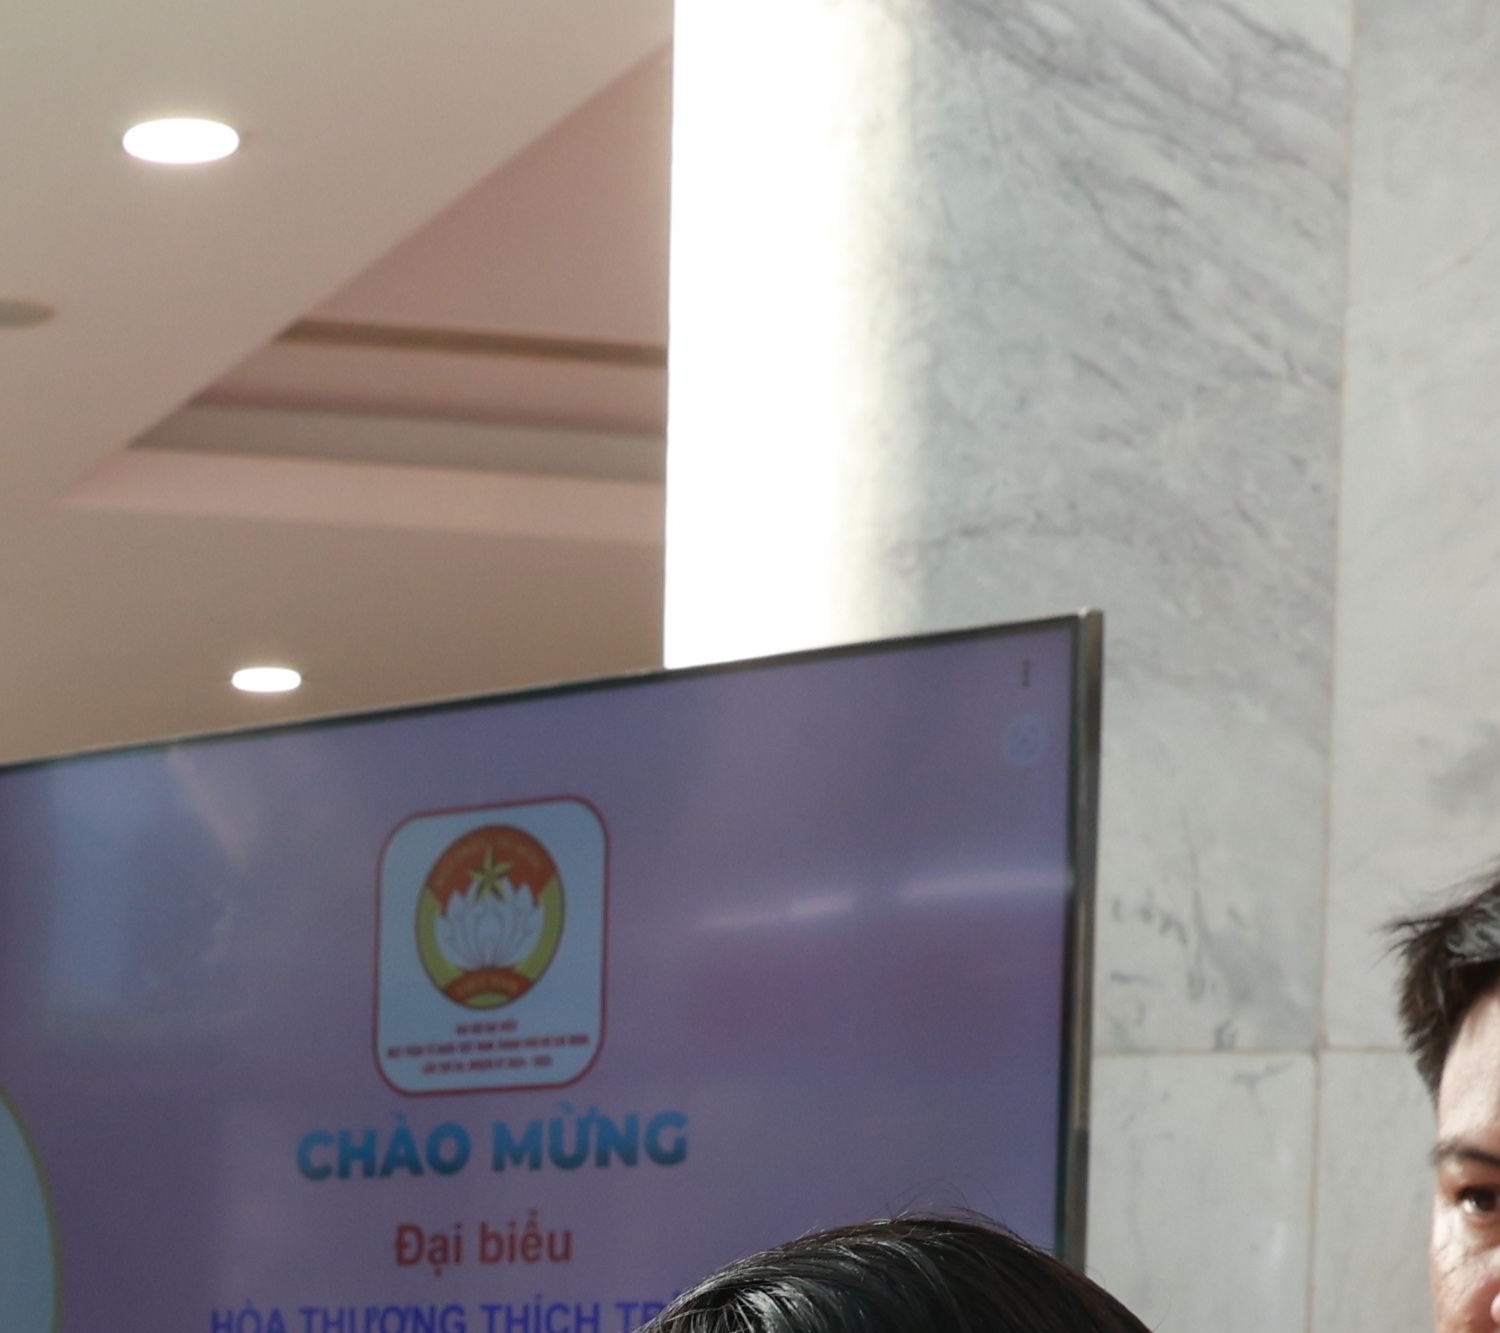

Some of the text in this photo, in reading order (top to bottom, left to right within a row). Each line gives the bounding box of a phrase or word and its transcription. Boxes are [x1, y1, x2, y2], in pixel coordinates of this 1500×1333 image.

[296, 1103, 689, 1182] CHÀO MỪNG
[393, 1209, 573, 1276] Đại biểu
